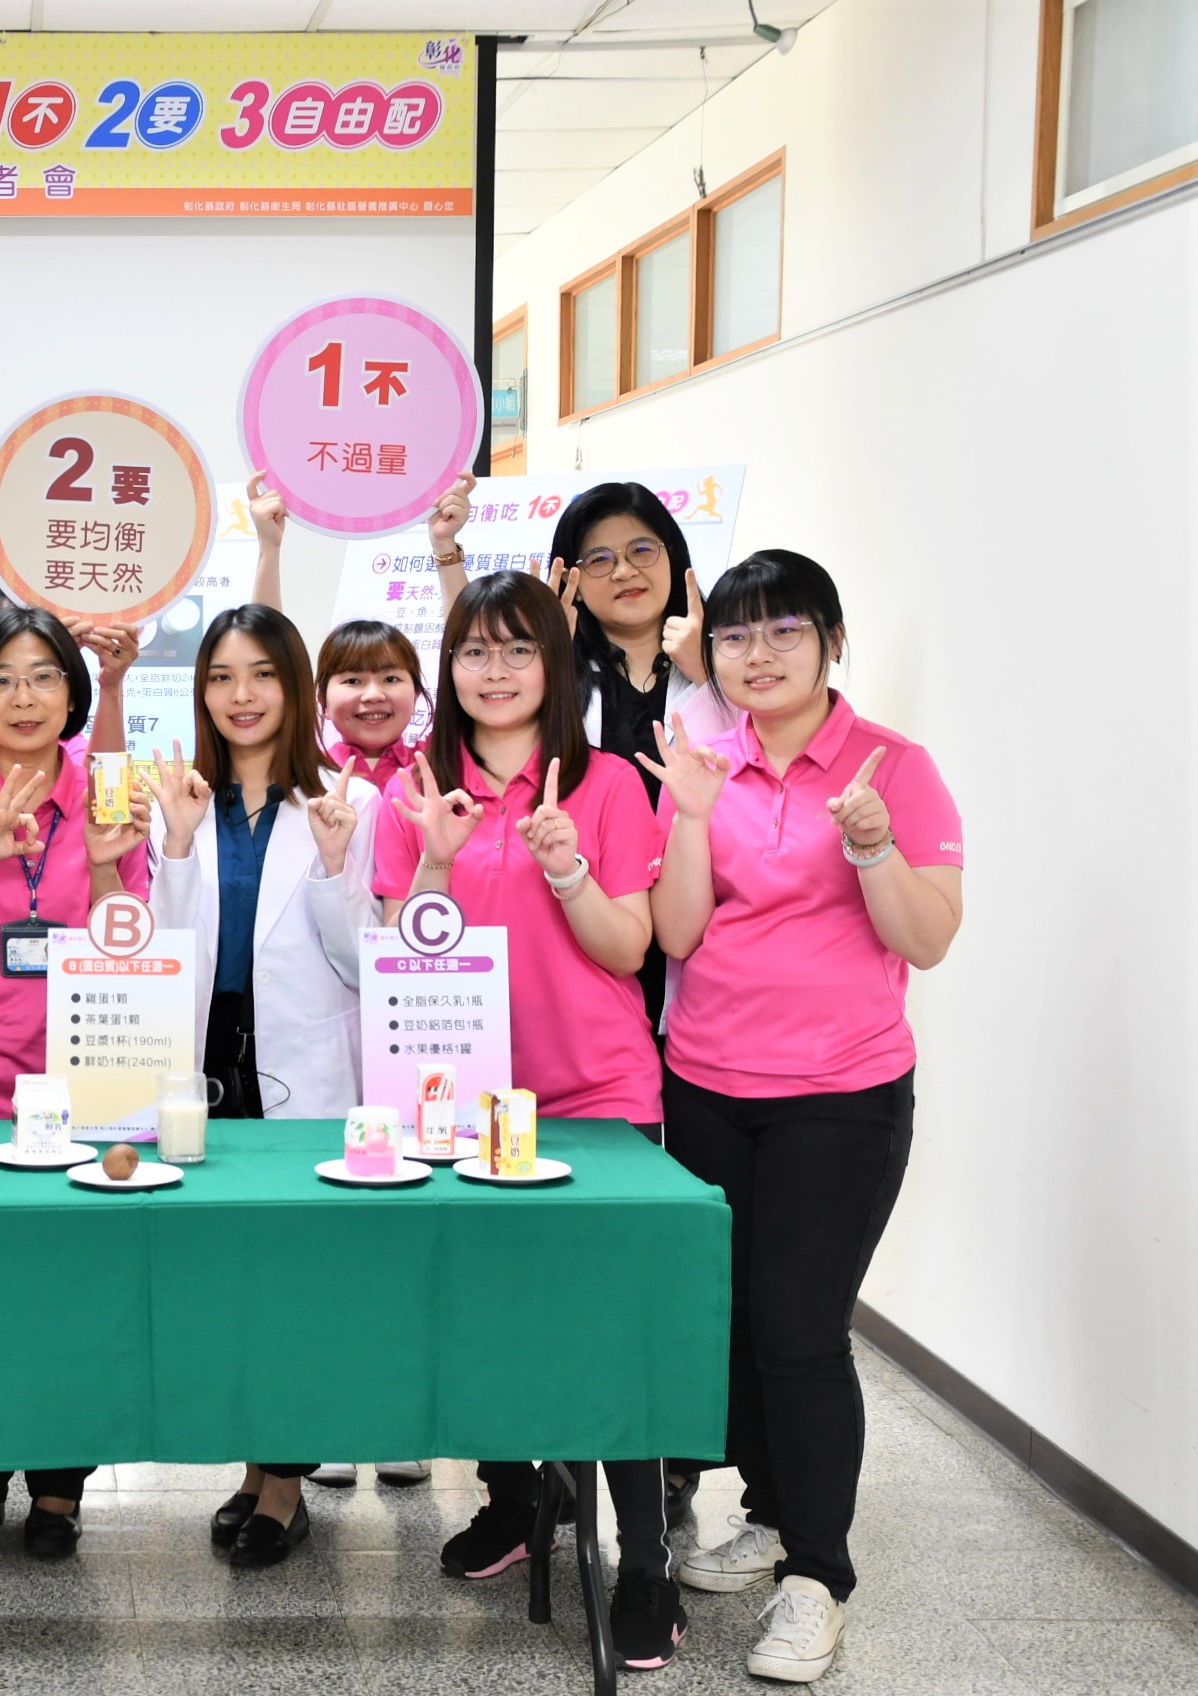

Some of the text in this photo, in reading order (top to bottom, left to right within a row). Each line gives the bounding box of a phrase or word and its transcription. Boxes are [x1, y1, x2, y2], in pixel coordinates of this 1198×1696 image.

[306, 441, 408, 475] 不過量
[45, 519, 146, 553] 要均衡
[44, 559, 144, 594] 要天然
[103, 902, 142, 948] B
[411, 902, 450, 946] C
